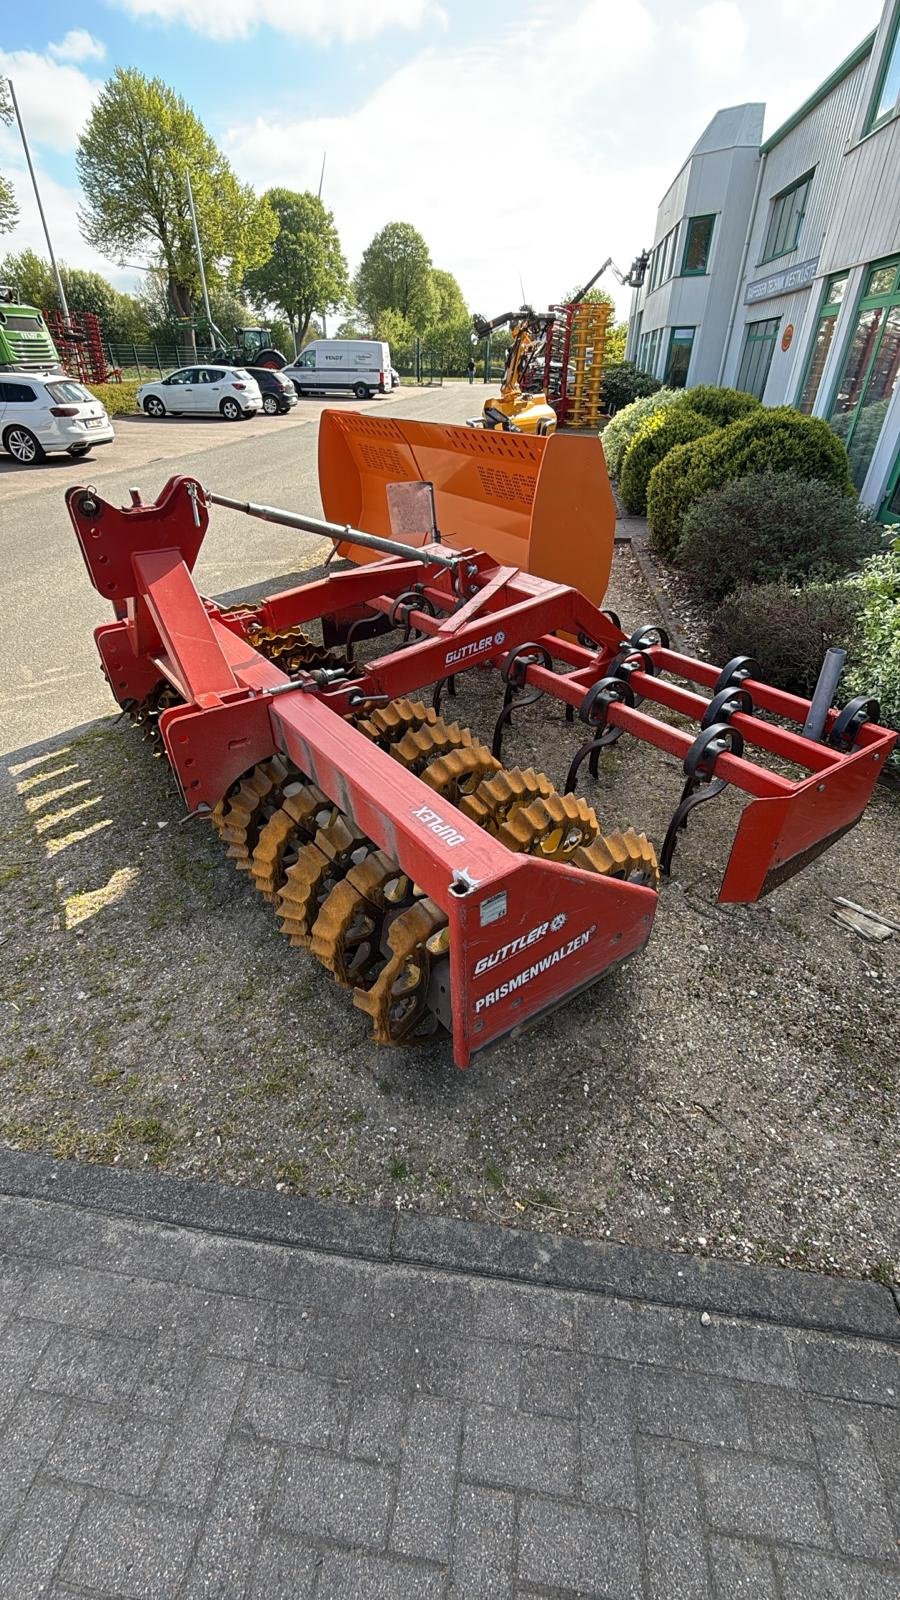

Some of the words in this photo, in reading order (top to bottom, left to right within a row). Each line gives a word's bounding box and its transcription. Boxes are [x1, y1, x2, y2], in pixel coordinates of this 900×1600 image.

[445, 636, 493, 664] GÜTTLER
[412, 805, 466, 847] DUPLEX
[474, 921, 550, 975] GÜTTLER
